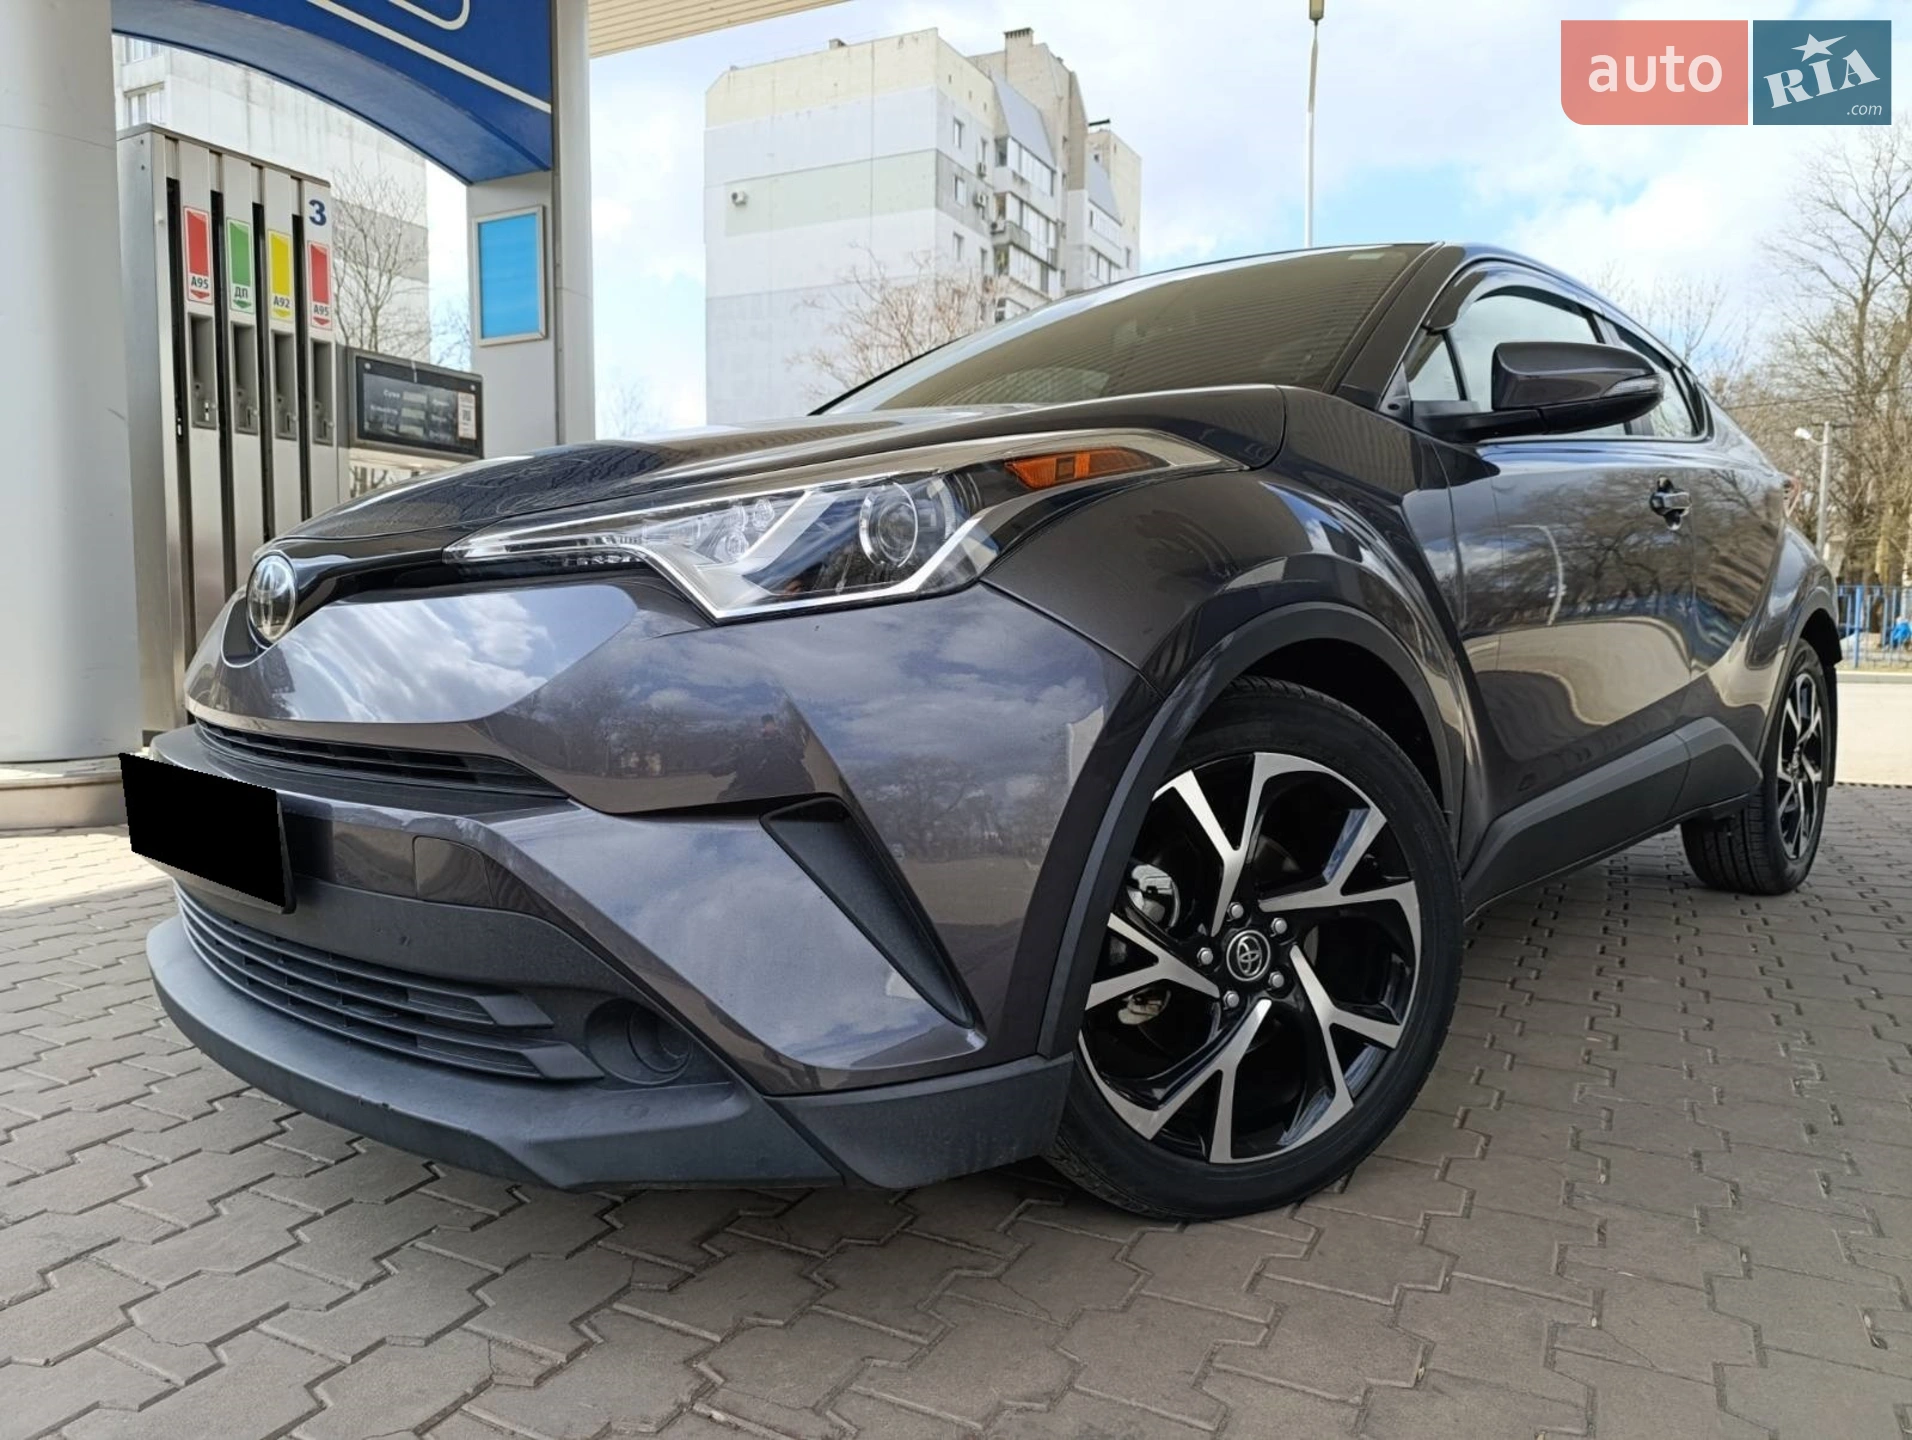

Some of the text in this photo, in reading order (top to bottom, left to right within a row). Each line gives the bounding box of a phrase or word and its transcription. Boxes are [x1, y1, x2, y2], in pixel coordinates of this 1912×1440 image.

[308, 199, 327, 227] 3
[190, 276, 209, 290] А95
[234, 286, 249, 299] ДП
[313, 304, 330, 317] А95
